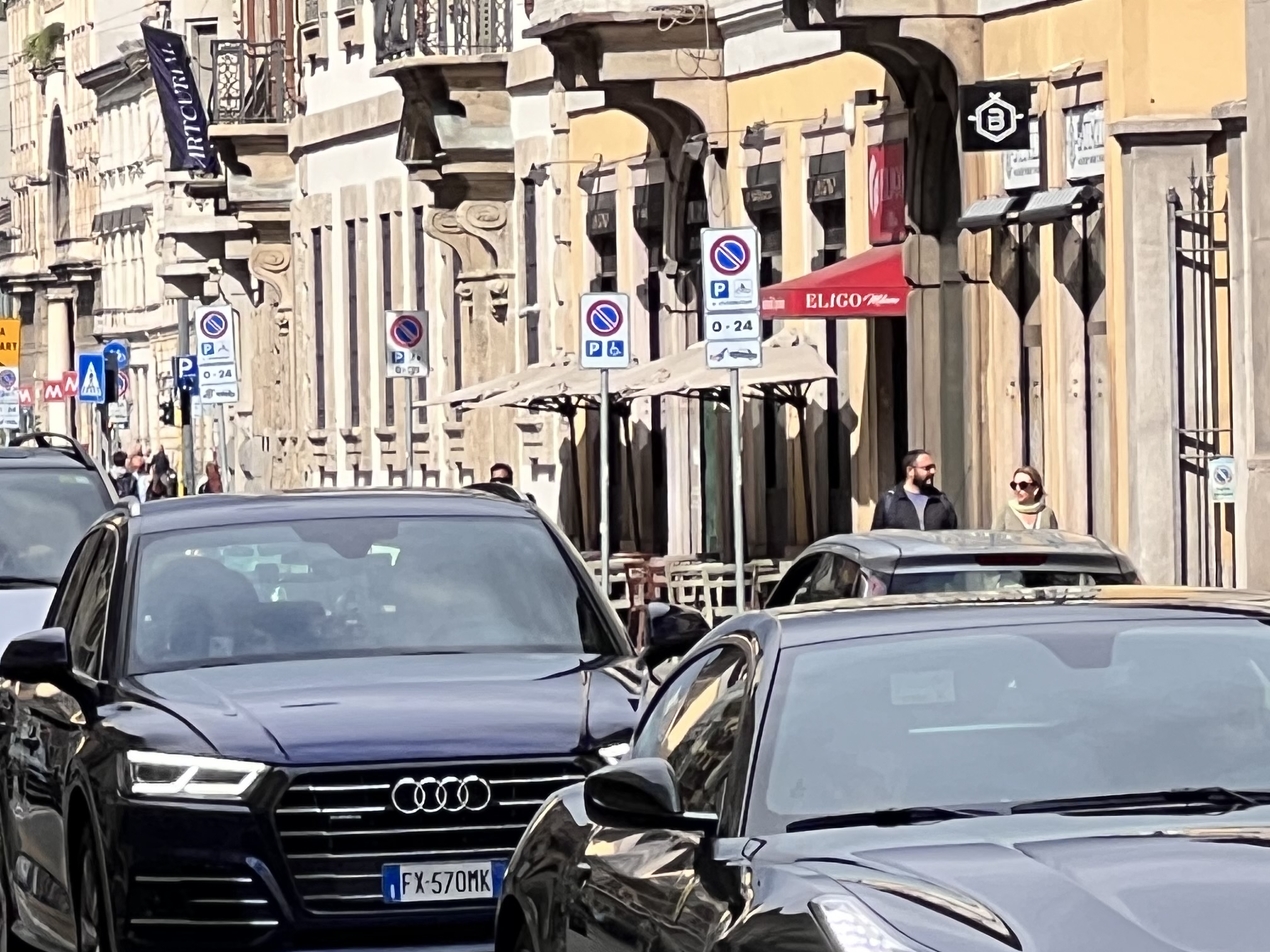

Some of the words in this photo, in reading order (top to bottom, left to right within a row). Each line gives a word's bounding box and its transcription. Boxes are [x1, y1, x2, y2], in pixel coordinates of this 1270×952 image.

[714, 283, 725, 297] P
[806, 293, 862, 309] ELIGO
[204, 343, 212, 355] P
[589, 342, 599, 356] P
[178, 358, 193, 378] P
[45, 384, 62, 399] M
